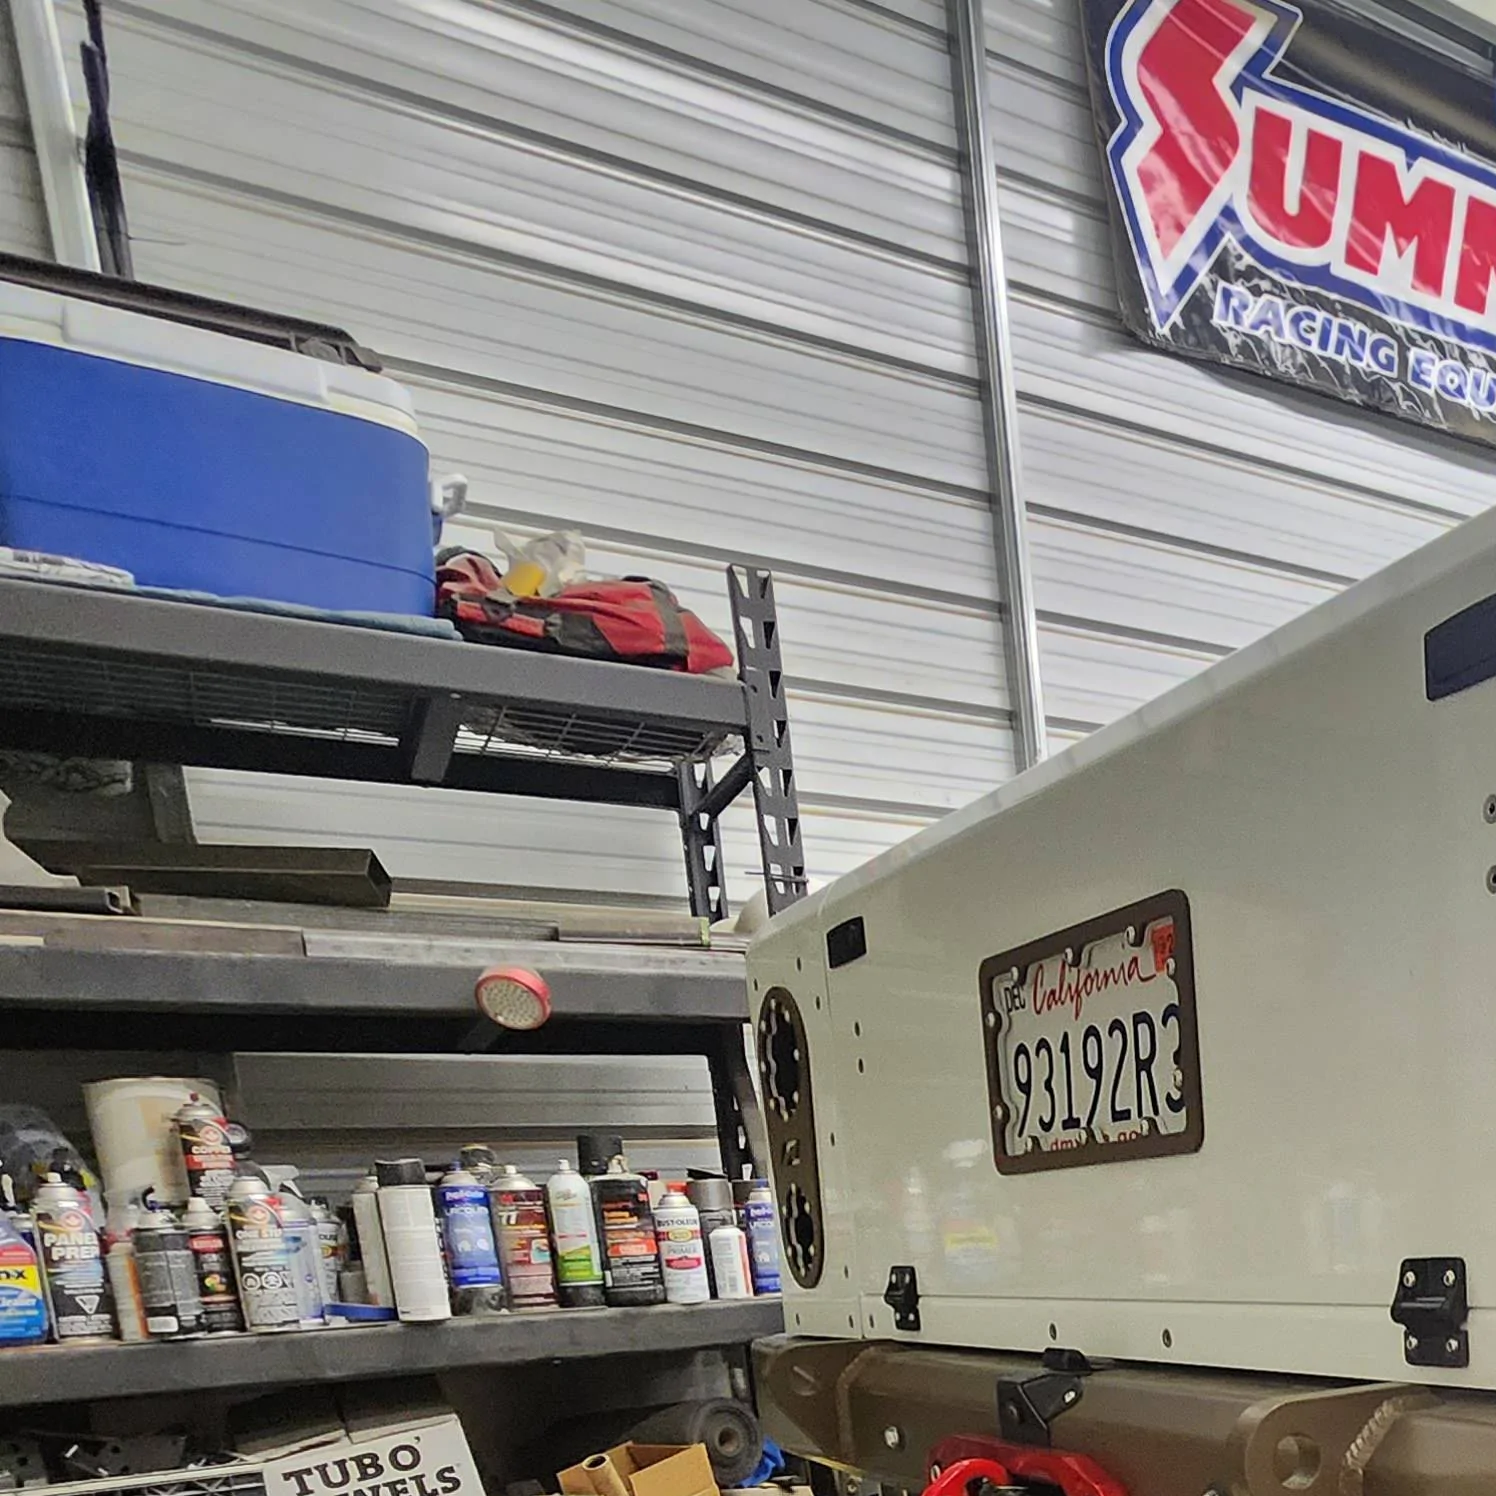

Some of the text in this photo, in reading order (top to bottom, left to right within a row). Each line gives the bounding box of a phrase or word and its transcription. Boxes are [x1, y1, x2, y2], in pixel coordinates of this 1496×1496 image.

[1212, 281, 1399, 378] RACING
[1032, 955, 1156, 1021] California
[1013, 1003, 1187, 1139] 93192R3
[44, 1232, 98, 1247] PANE
